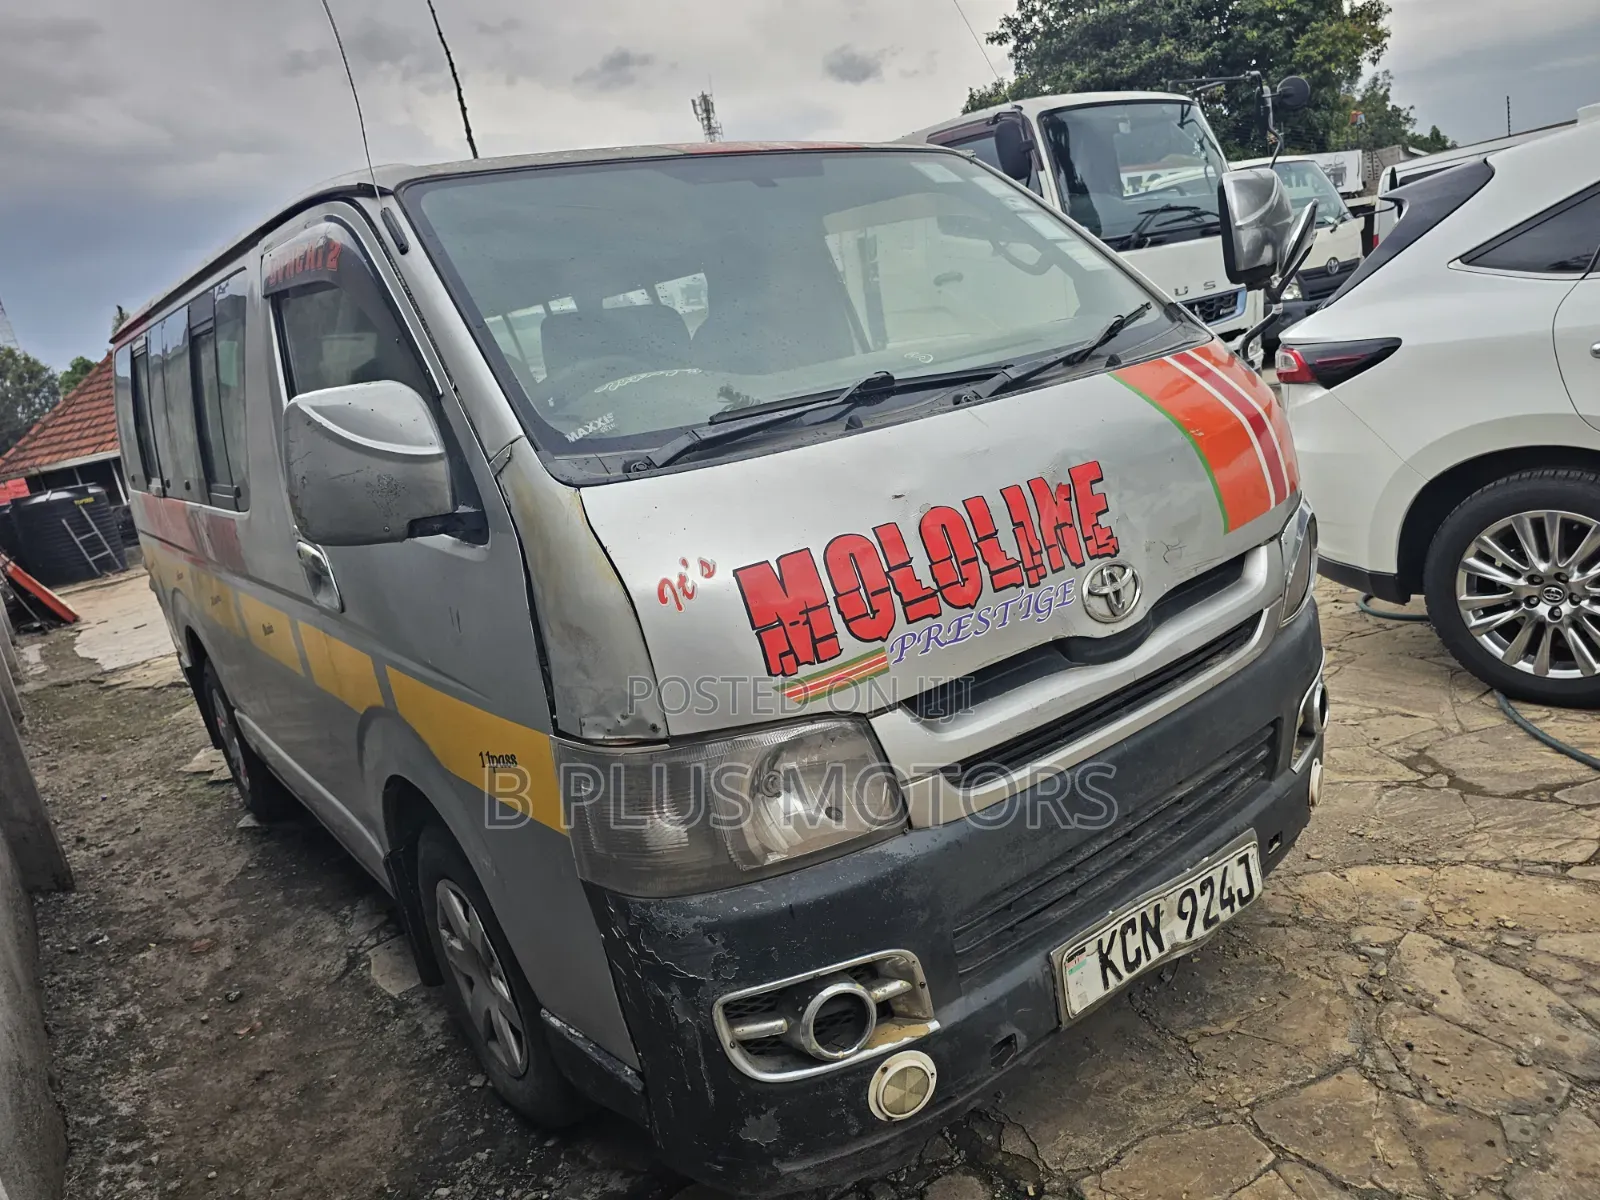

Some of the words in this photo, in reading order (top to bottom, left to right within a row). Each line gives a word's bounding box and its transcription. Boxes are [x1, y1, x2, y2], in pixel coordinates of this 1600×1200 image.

[733, 460, 1119, 677] MOLOLINE
[889, 577, 1077, 665] PRESTIGE
[1097, 902, 1166, 992] KCN
[1177, 852, 1256, 940] 924J
